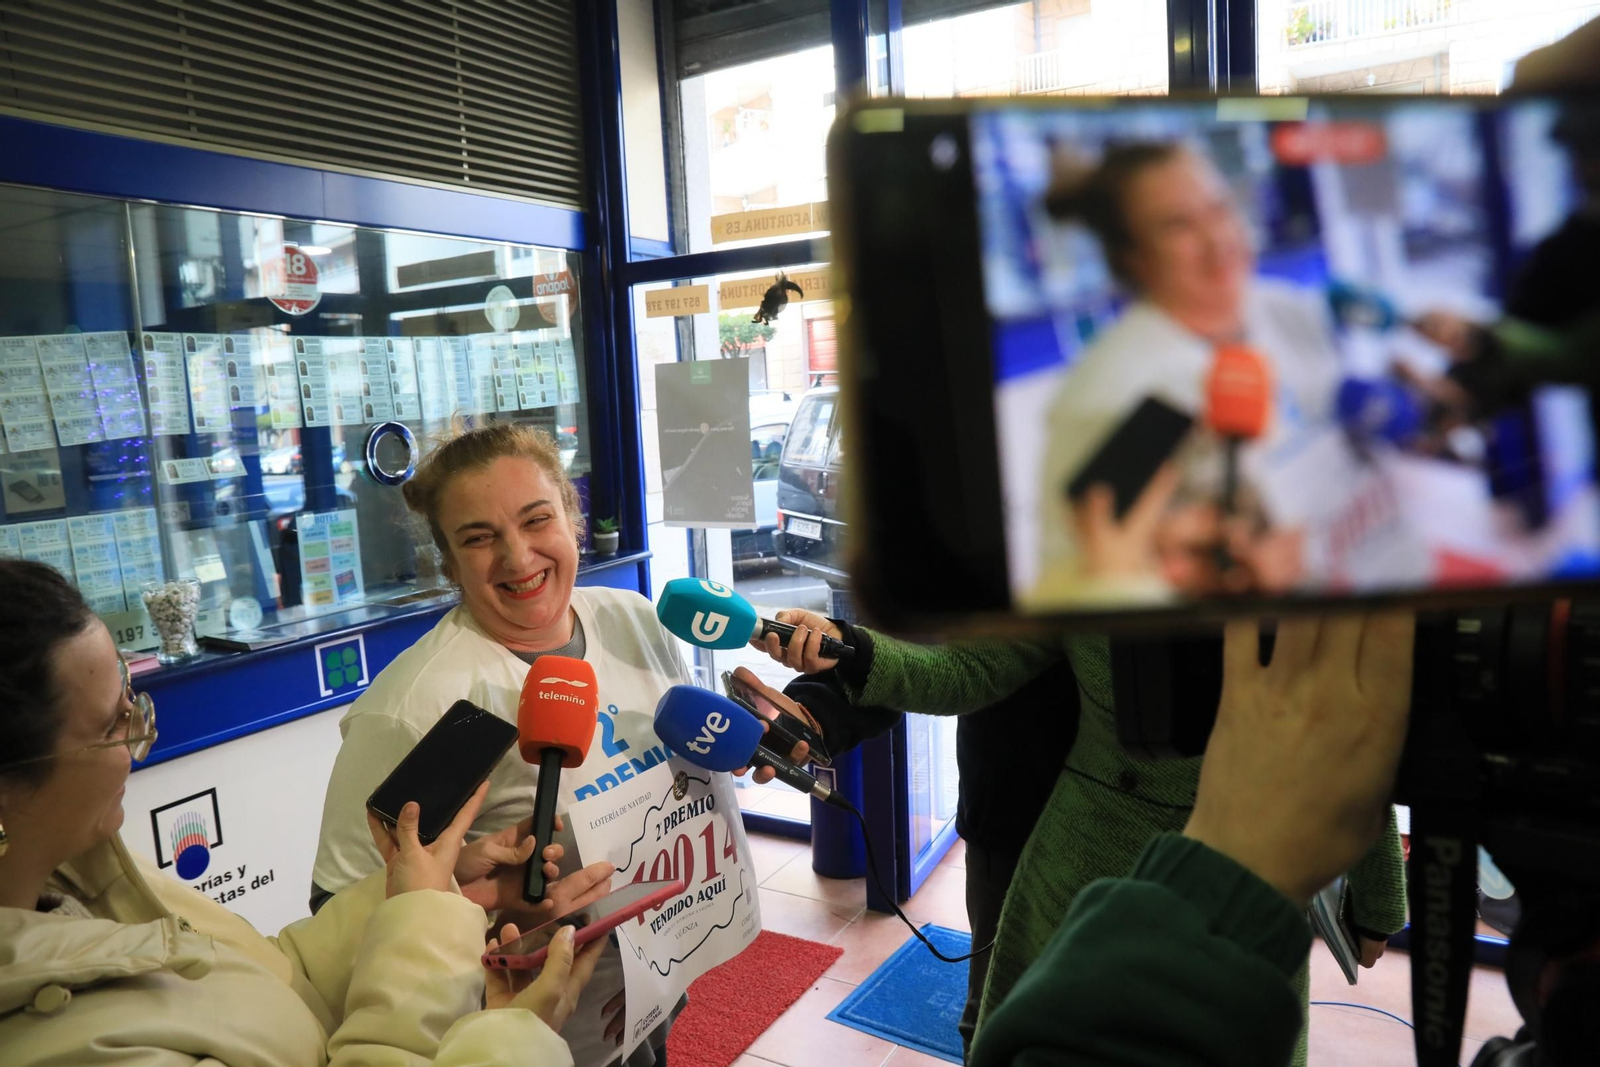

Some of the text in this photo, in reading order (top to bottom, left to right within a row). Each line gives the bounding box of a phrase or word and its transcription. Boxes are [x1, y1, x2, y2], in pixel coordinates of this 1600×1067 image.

[536, 276, 571, 295] anapal
[314, 513, 339, 525] BOTES
[116, 625, 144, 645] 197
[538, 690, 586, 706] telemiño
[685, 711, 731, 754] tve
[589, 791, 652, 830] LOTERÍA DE NAVIDAD
[663, 793, 715, 836] PREMIO
[237, 864, 247, 879] y
[251, 869, 274, 890] del
[649, 894, 694, 935] VENDIDO
[696, 874, 727, 904] AQUÍ
[1423, 834, 1462, 1050] Panasonic
